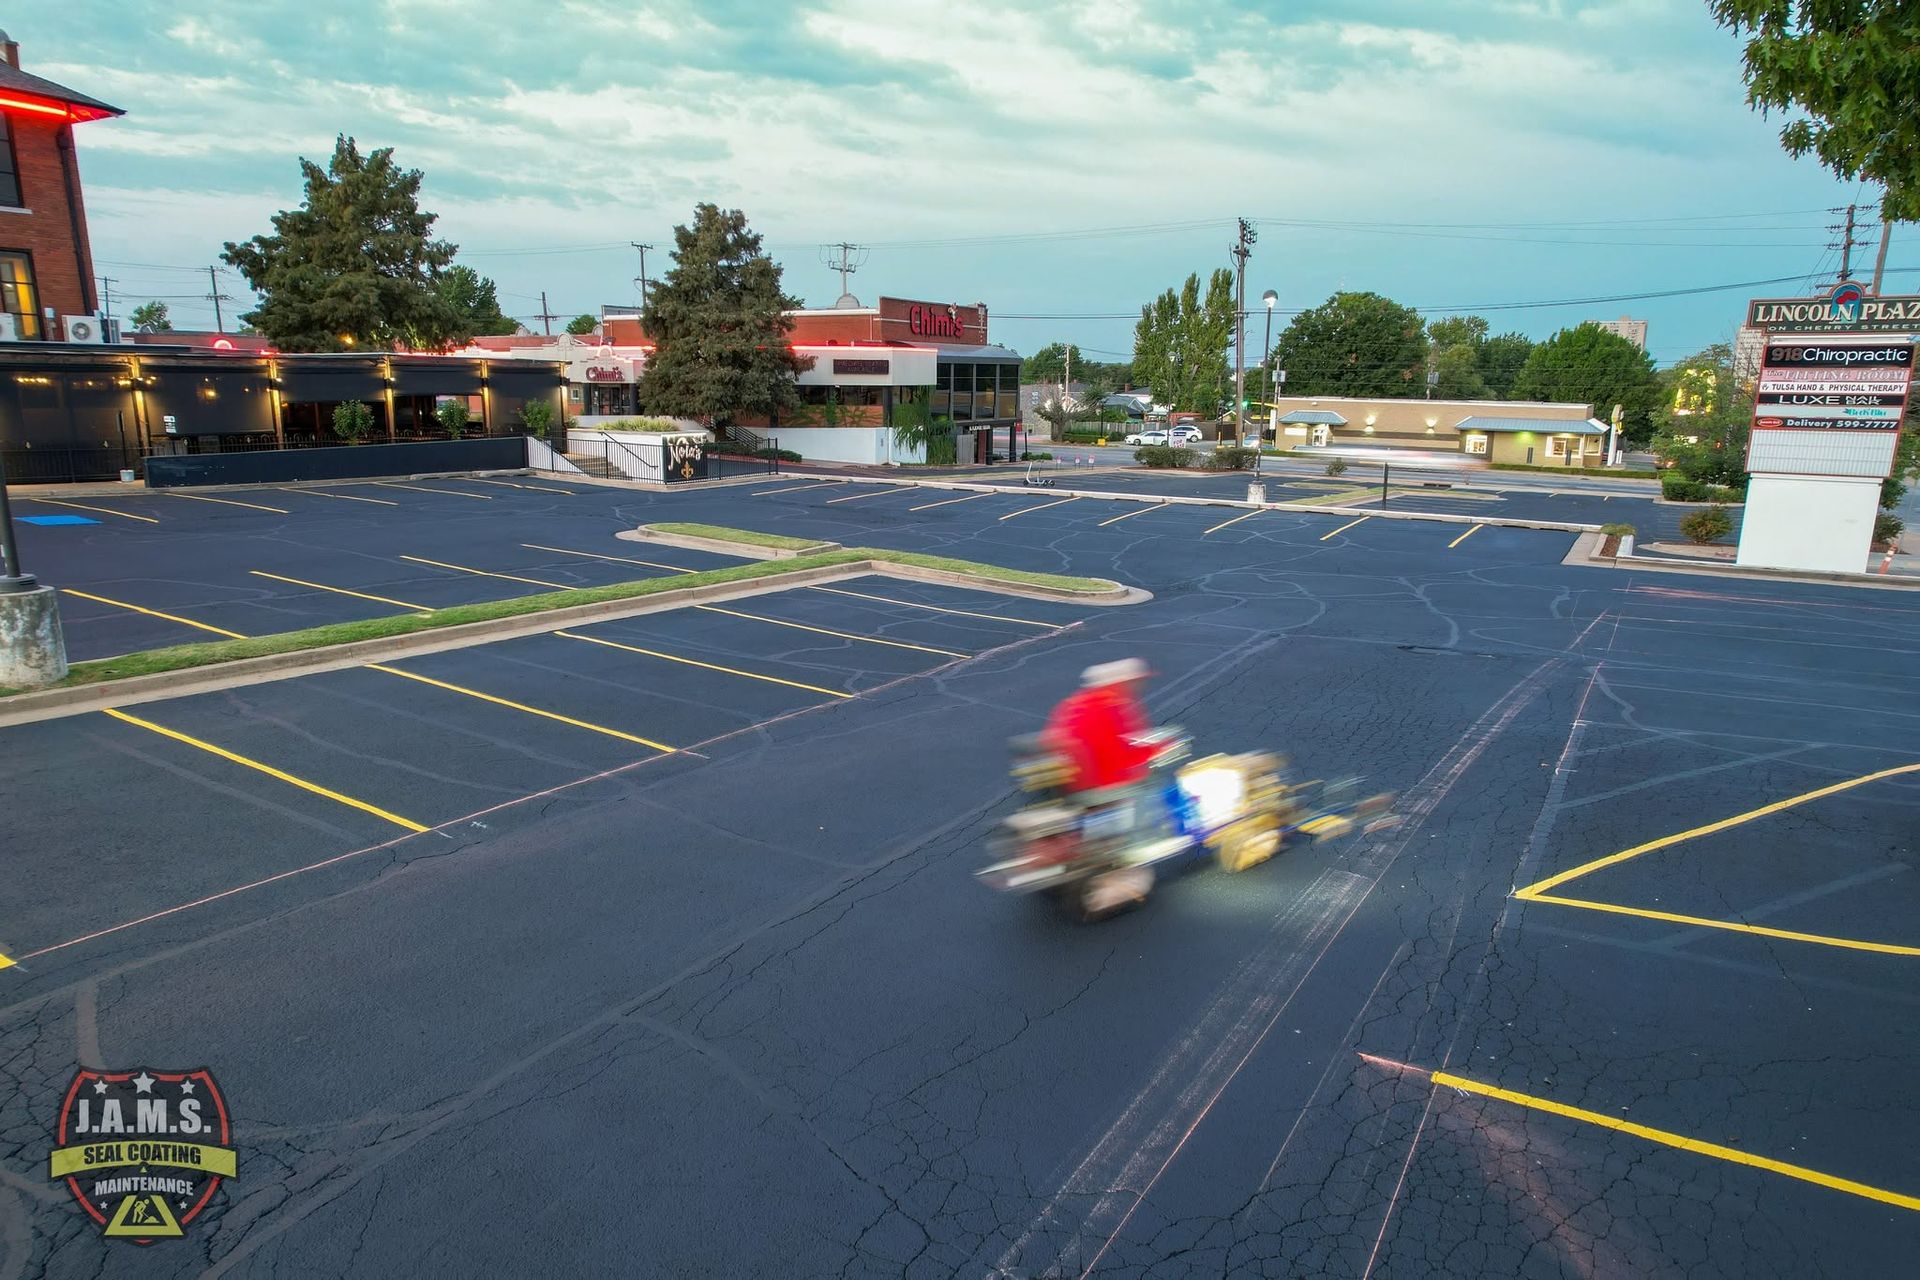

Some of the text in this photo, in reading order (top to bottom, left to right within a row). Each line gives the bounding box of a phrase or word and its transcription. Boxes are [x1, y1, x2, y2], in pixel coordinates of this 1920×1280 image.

[1756, 304, 1854, 322] LINCOLN
[1828, 384, 1865, 392] PHYSICAL
[1778, 394, 1840, 405] LUXE
[1786, 419, 1833, 429] Delivery
[1836, 420, 1897, 429] 599-7777
